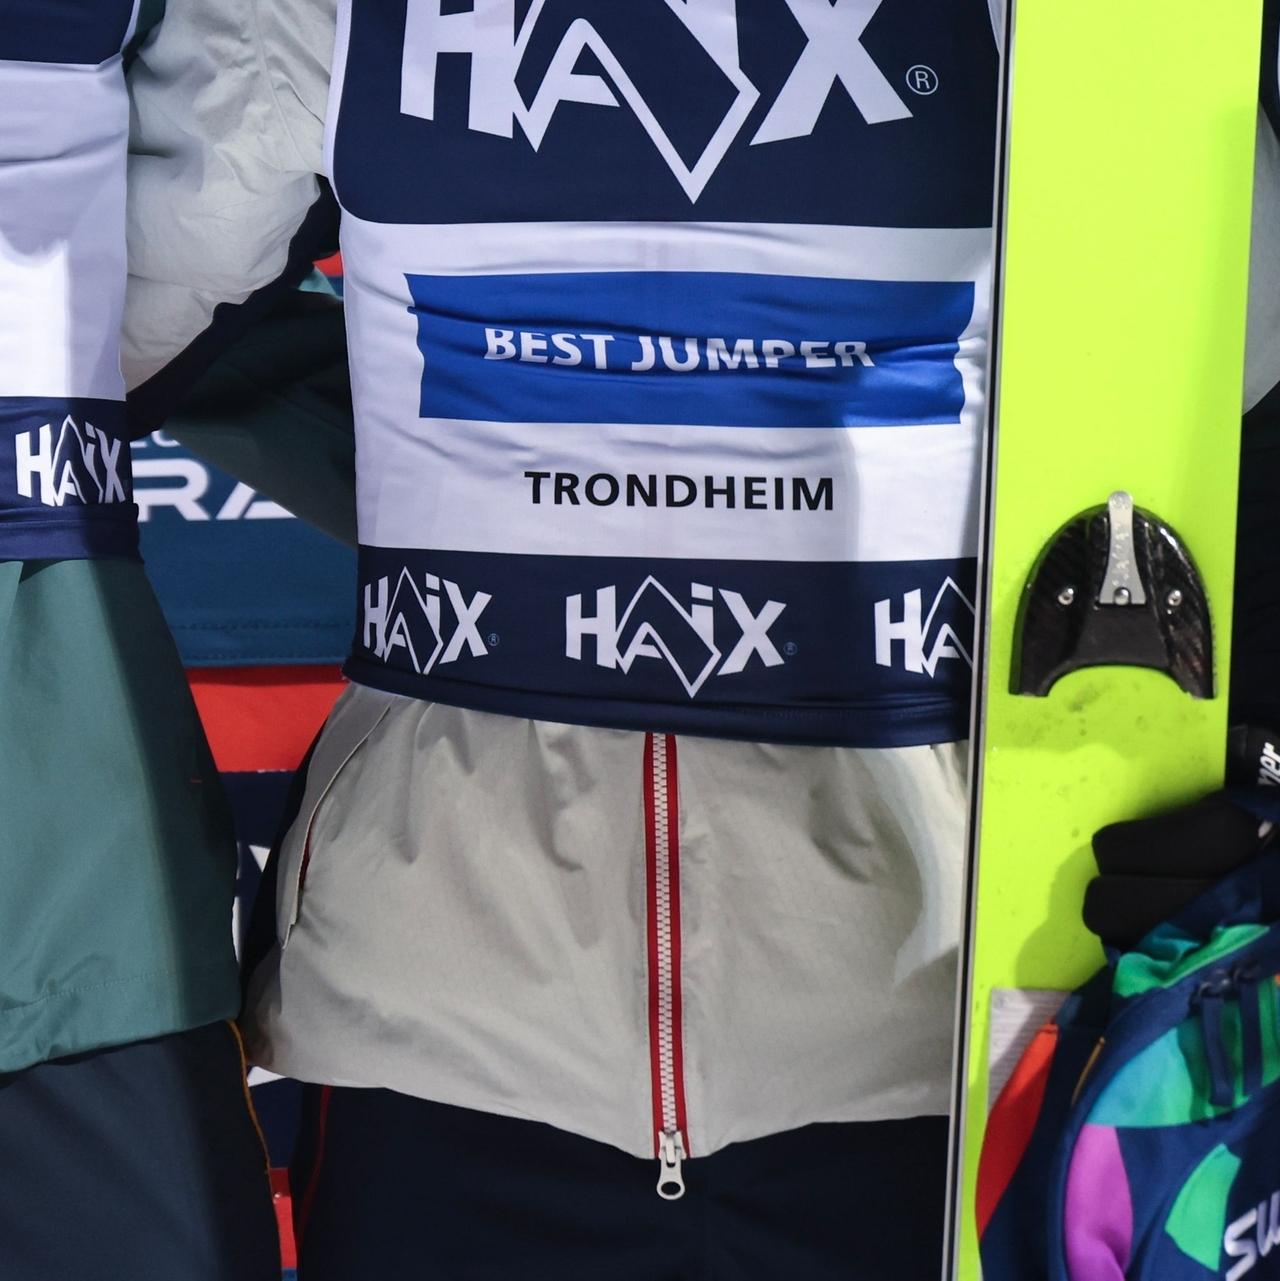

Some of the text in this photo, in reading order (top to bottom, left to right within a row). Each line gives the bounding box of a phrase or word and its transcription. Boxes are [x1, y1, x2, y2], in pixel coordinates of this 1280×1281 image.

[484, 327, 876, 374] BEST JUMPER
[524, 470, 835, 512] TRONDHEIM
